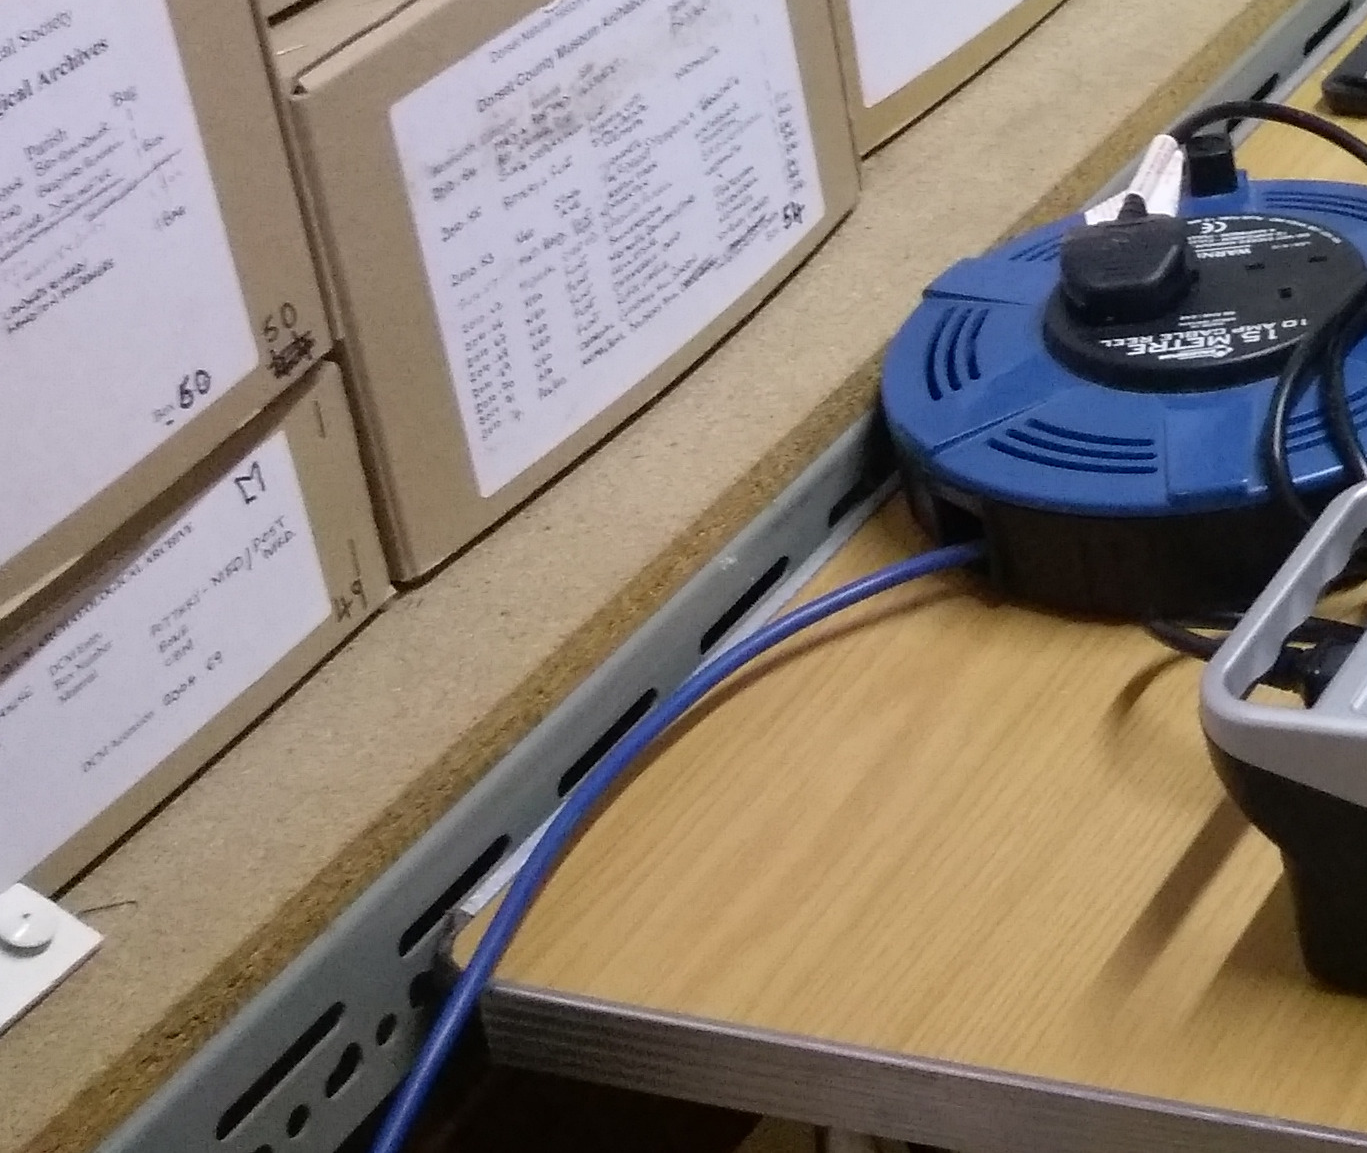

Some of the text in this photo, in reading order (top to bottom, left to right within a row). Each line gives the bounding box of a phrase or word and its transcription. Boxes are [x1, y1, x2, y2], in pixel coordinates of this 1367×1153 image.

[37, 38, 109, 86] Archives
[1159, 327, 1228, 341] CABLE
[1231, 321, 1277, 334] AMP
[1098, 334, 1155, 348] REEL
[1241, 327, 1279, 344] 15
[1125, 333, 1232, 357] METRE
